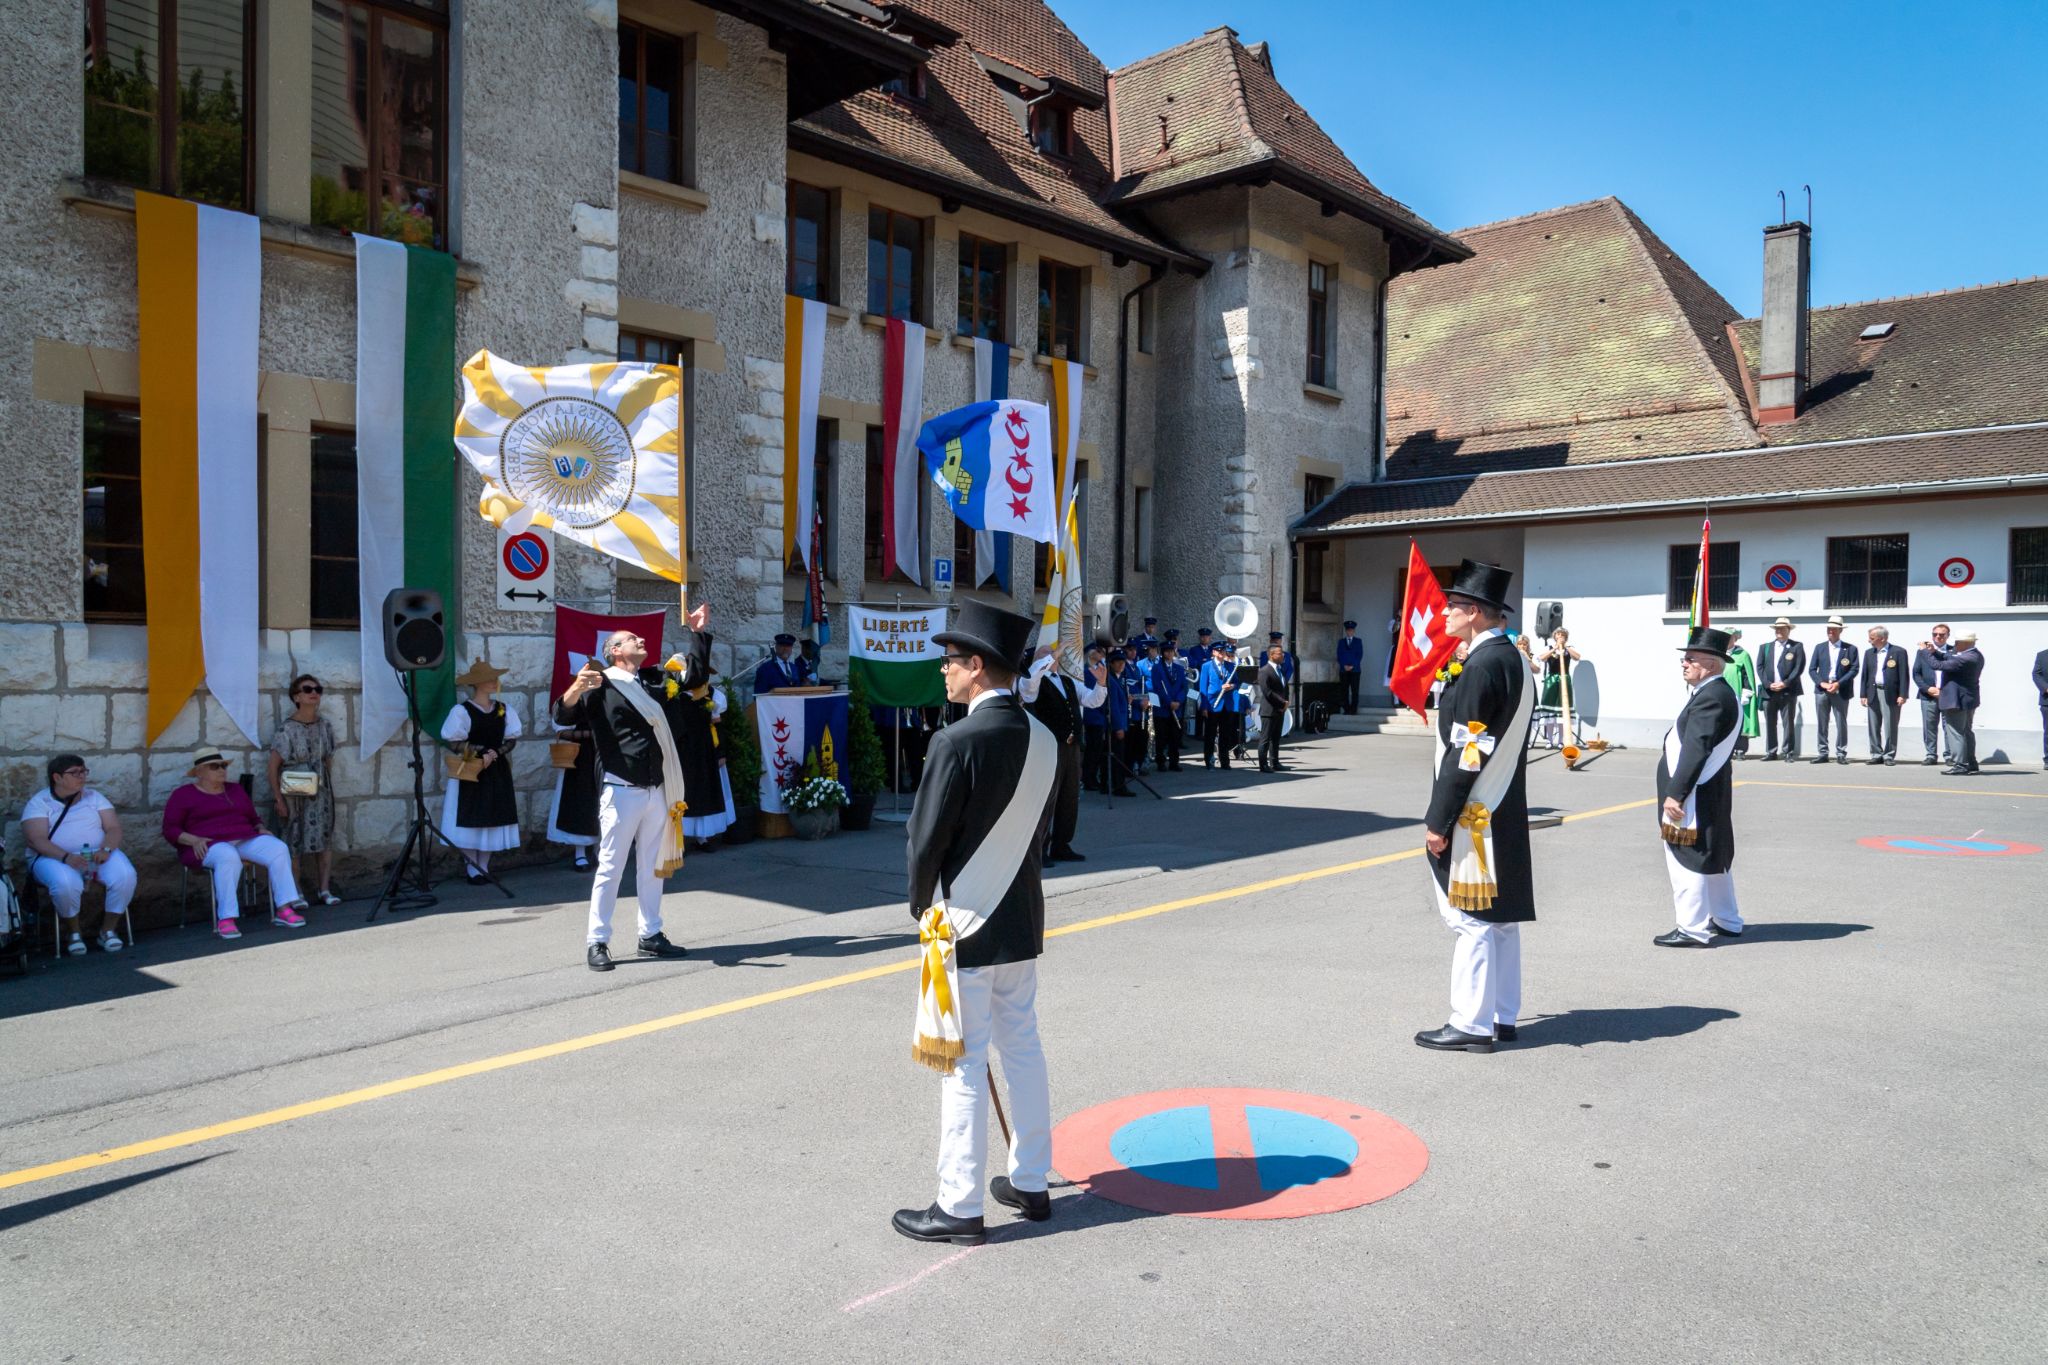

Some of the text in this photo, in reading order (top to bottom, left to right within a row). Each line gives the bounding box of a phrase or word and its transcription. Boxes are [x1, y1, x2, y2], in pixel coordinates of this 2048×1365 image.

[939, 561, 948, 579] P
[862, 616, 930, 632] LIBERTÉ
[865, 638, 926, 653] PATRIE
